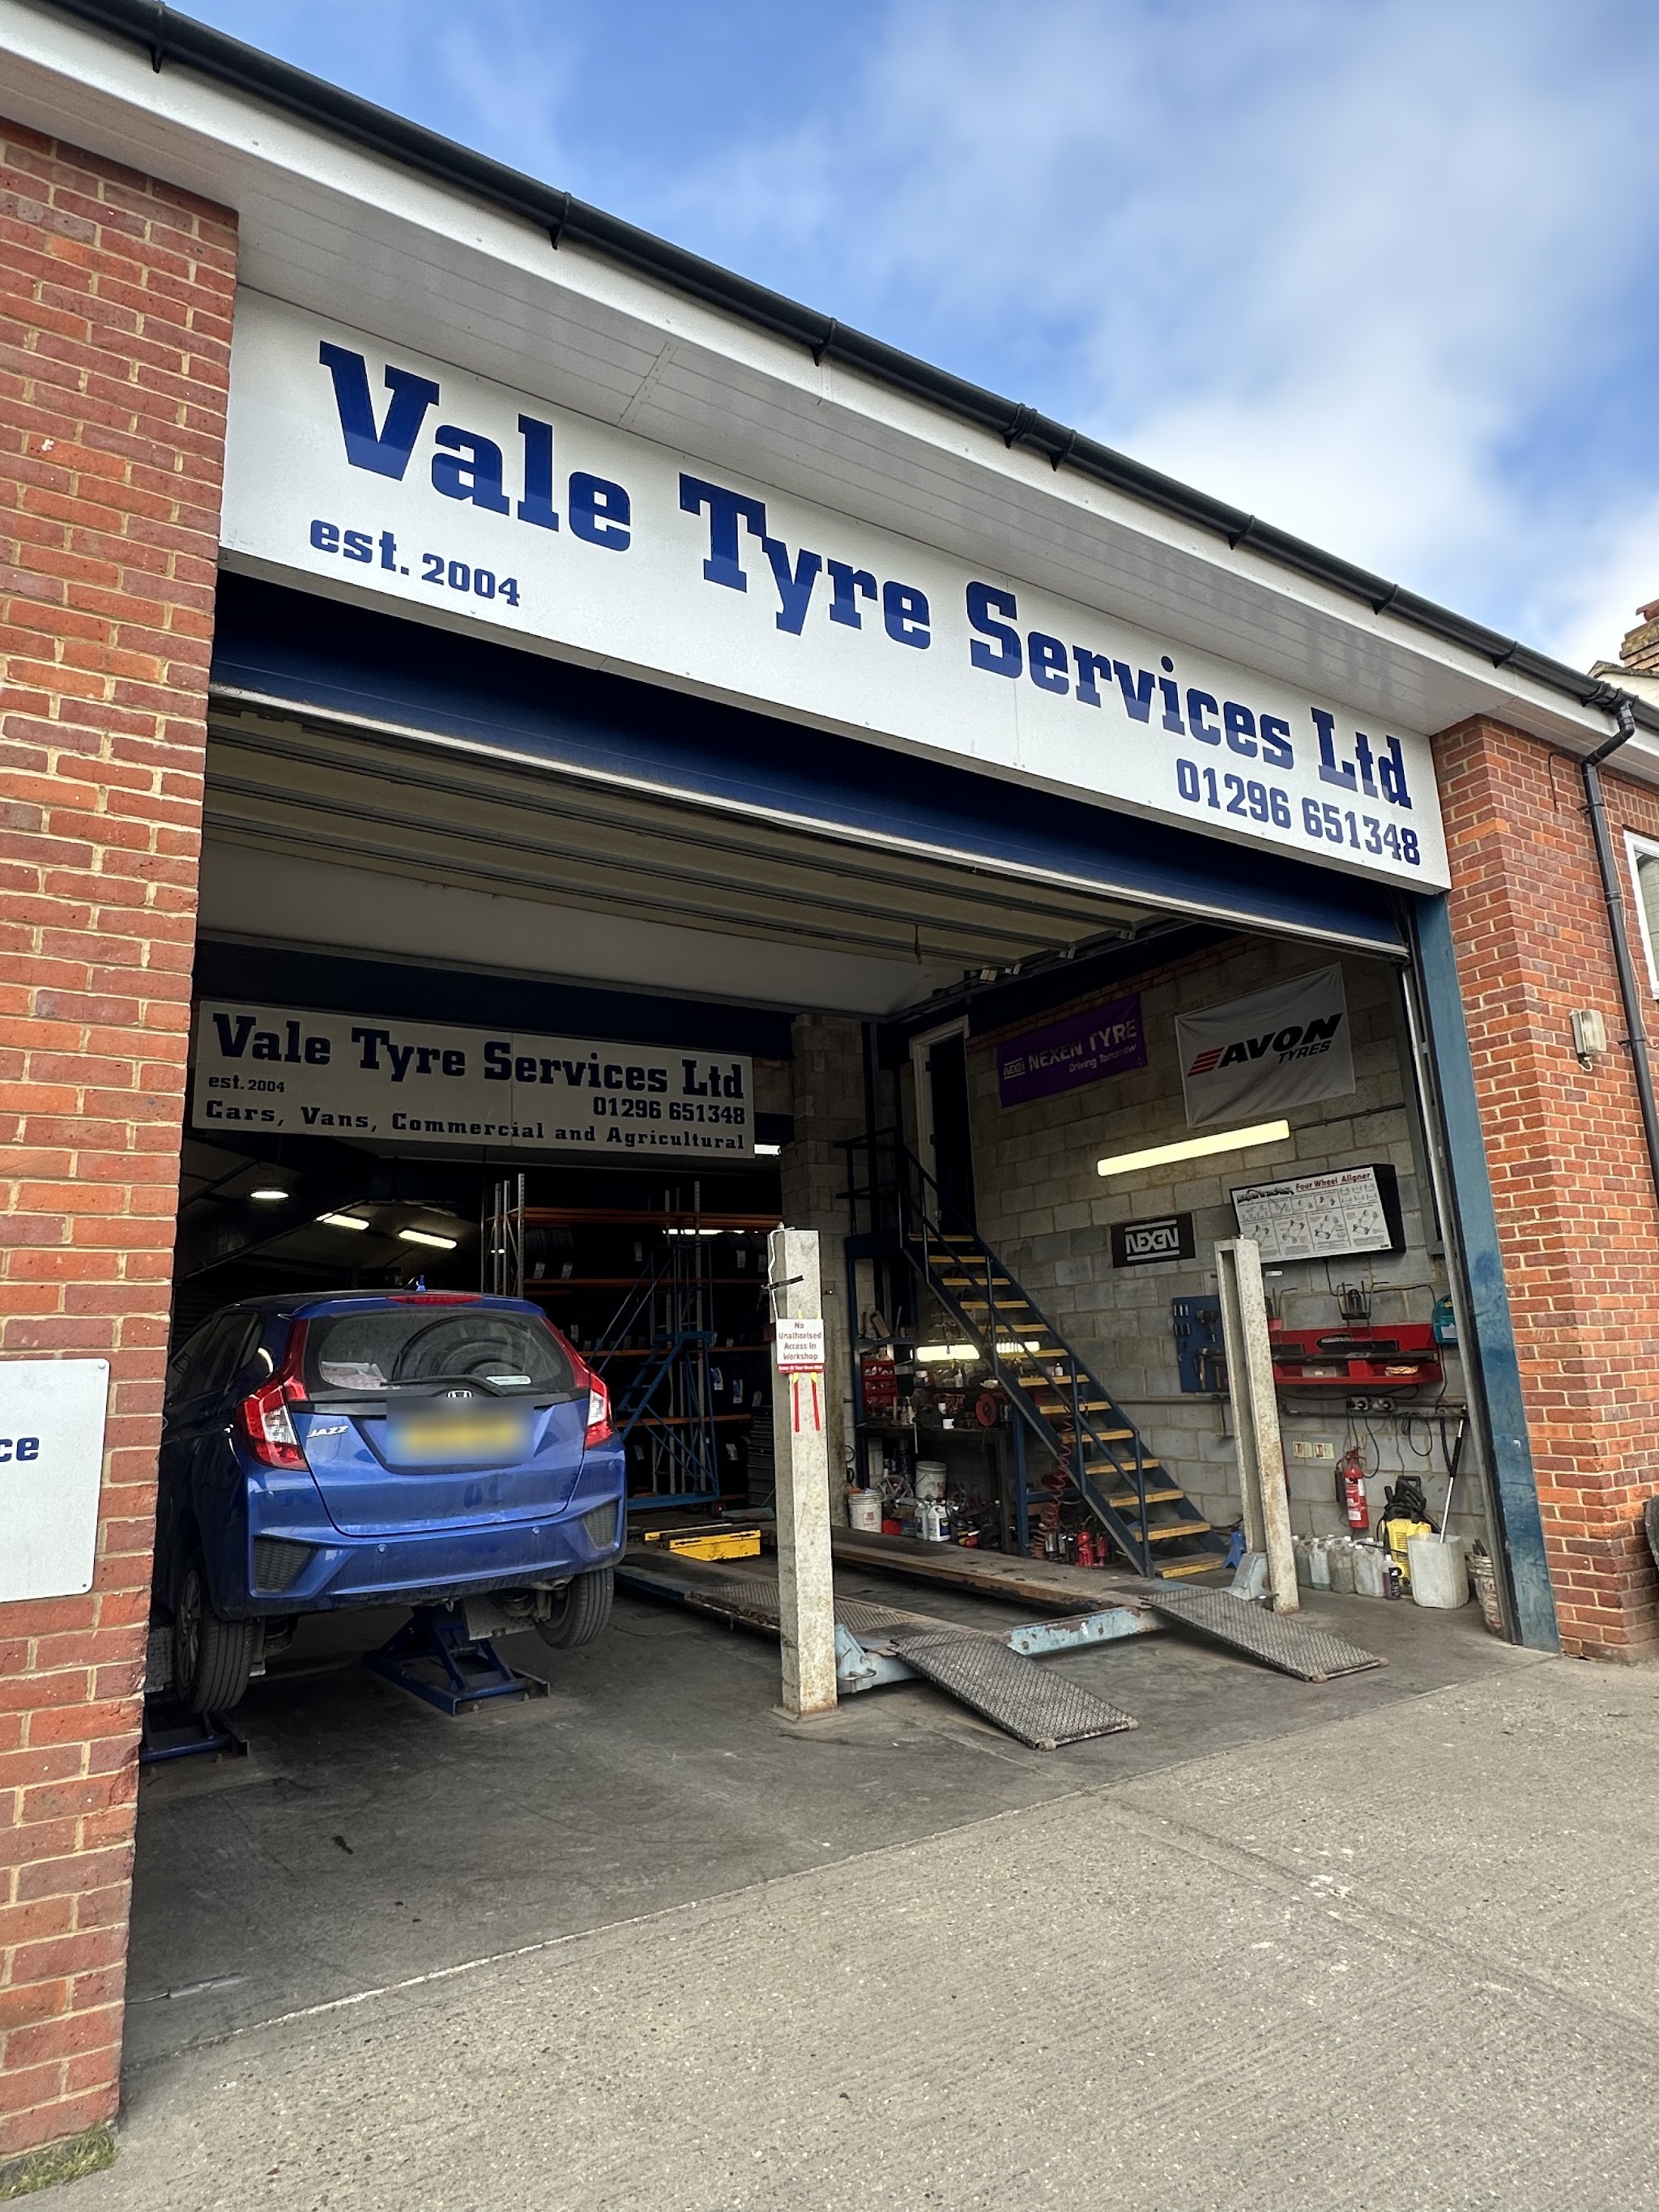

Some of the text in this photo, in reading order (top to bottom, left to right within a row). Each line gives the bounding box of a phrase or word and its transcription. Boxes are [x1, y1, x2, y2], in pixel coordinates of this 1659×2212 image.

[309, 519, 521, 608] est. 2004
[319, 340, 1413, 810] Vale Tyre Services Ltd
[1176, 758, 1422, 866] 01296 651348
[212, 1013, 744, 1099] Vale Tyre Services Ltd
[1028, 1040, 1084, 1072] NEXEN
[1089, 1018, 1137, 1052] TYRE
[1069, 1044, 1137, 1073] Driving Tomorrow
[1218, 1012, 1344, 1068] AVON
[1278, 1040, 1332, 1063] TYRES
[206, 1099, 744, 1149] Cars, Vans, Commercial and Agricultural
[593, 1096, 745, 1125] 01296 651348
[1296, 1173, 1371, 1191] Four Wheel Aligner
[1125, 1227, 1179, 1254] NEXEN
[783, 1353, 819, 1361] Workshop
[306, 1425, 348, 1438] JAZZ
